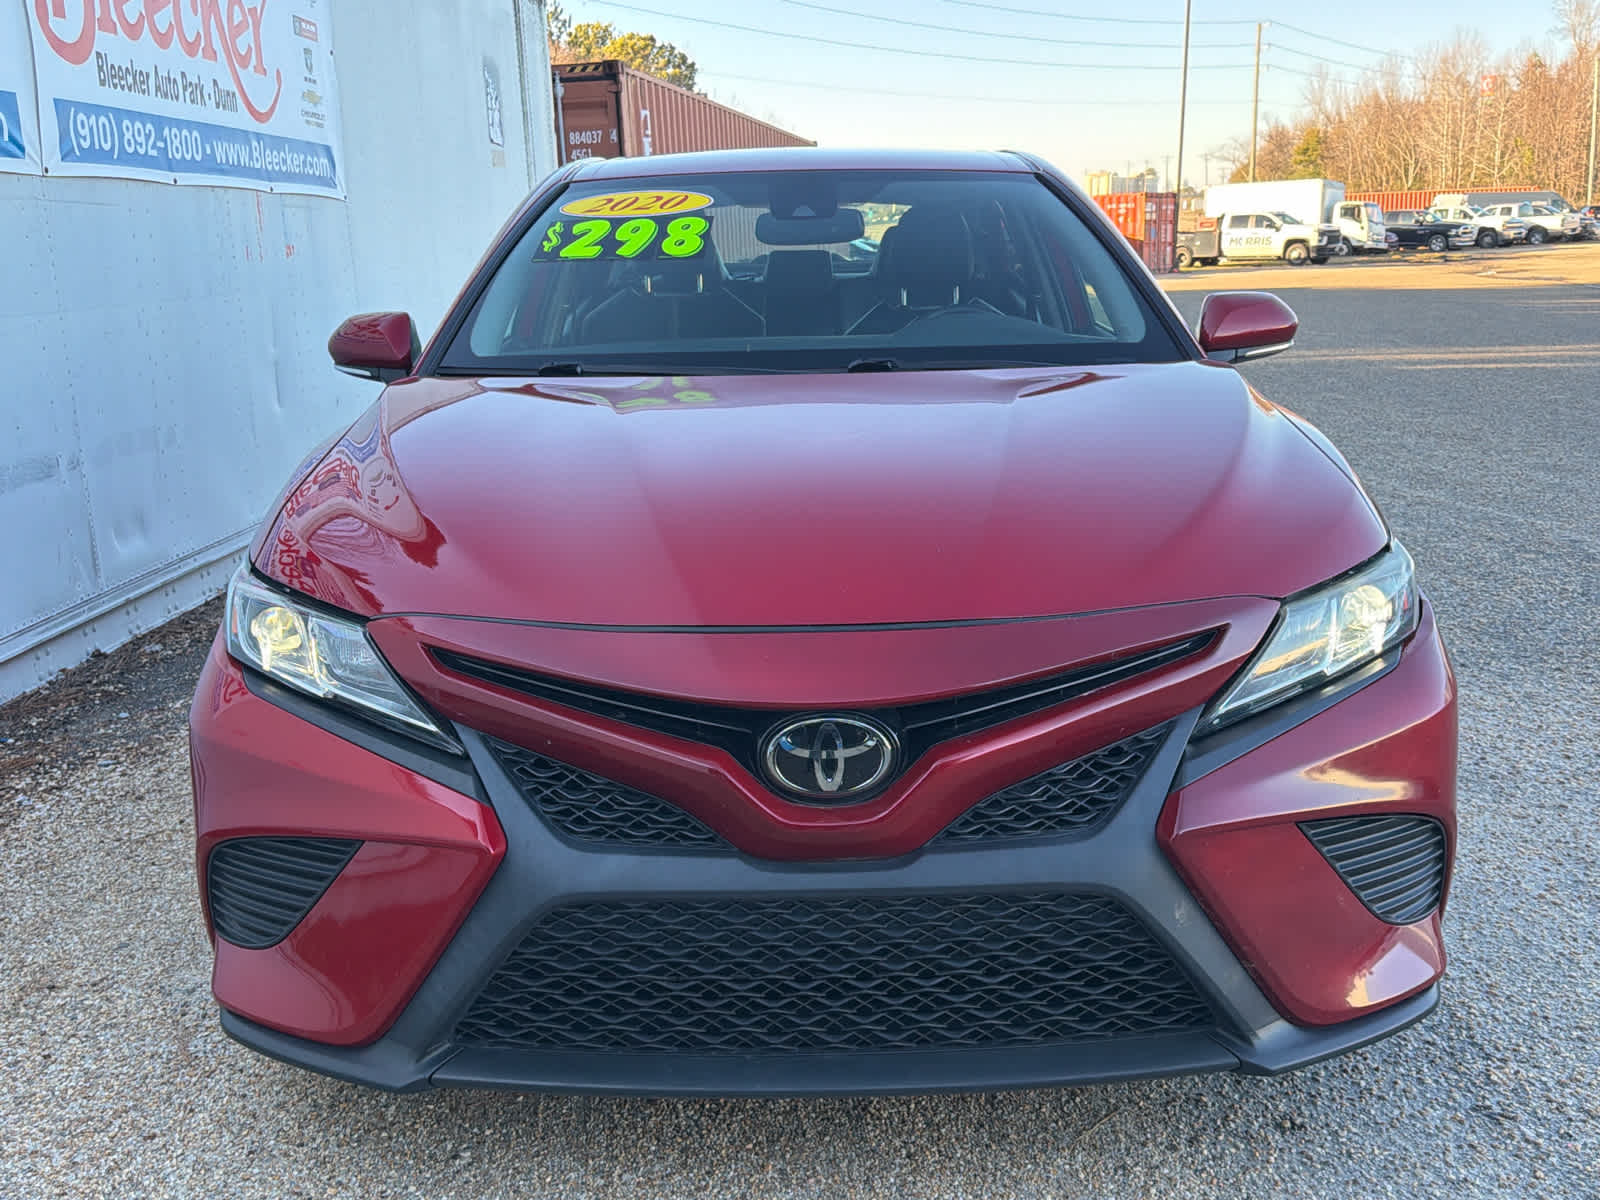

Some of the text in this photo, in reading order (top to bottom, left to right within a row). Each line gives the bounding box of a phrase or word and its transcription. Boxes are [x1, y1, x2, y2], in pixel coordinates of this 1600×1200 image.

[34, 0, 282, 123] eecker
[95, 50, 238, 112] Bleecker Auto Park Dunn
[69, 107, 331, 177] (910) 892-1800 www.Bleecker.com
[568, 130, 602, 144] 884037
[583, 194, 689, 213] 2020
[542, 216, 709, 258] $298
